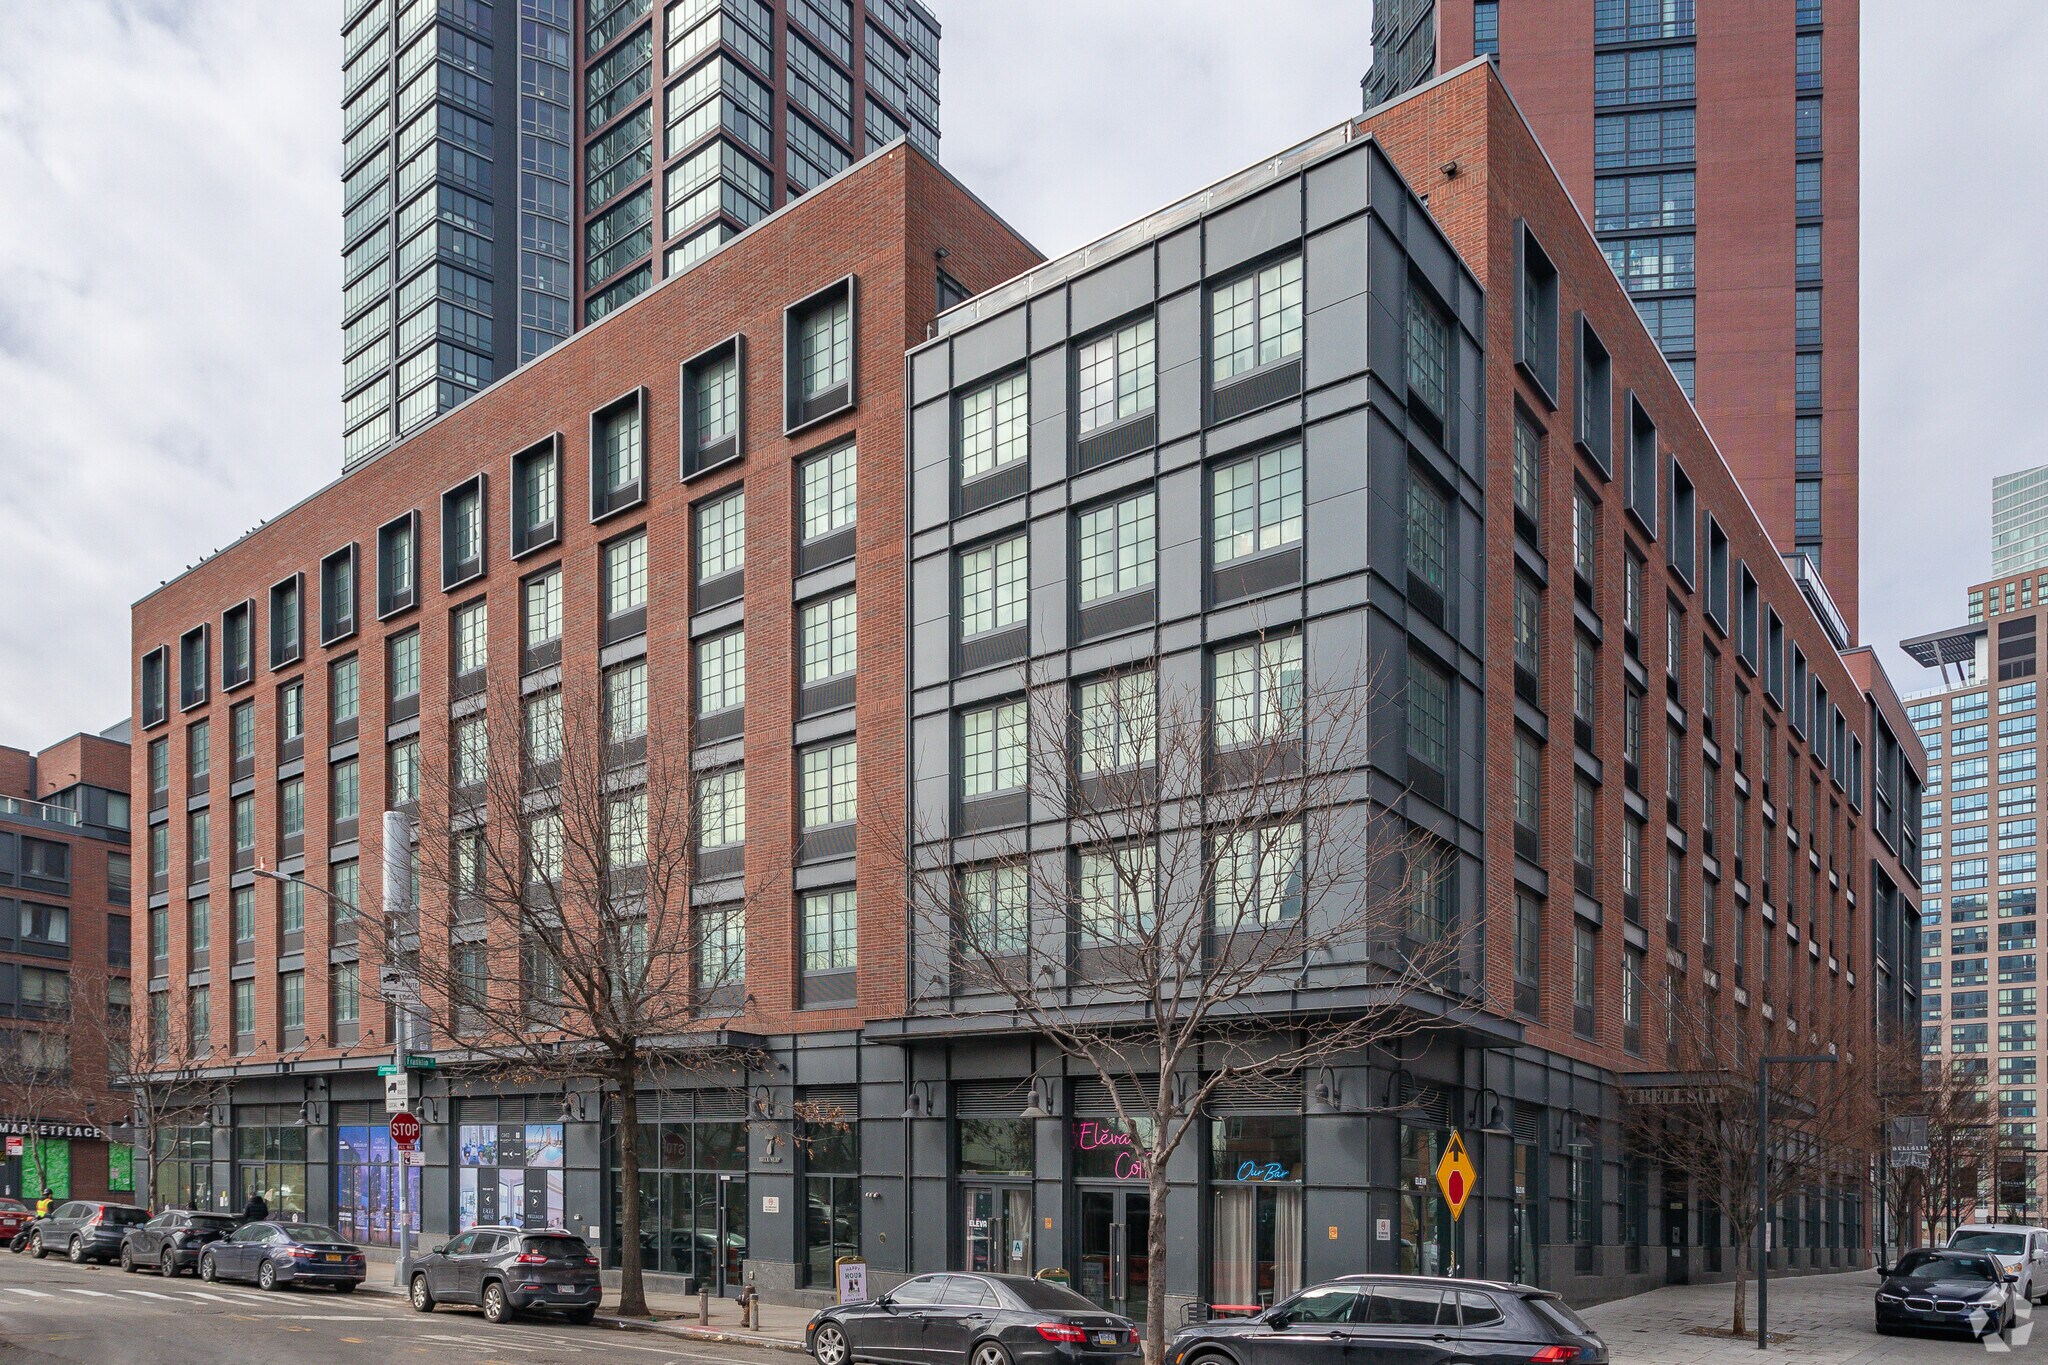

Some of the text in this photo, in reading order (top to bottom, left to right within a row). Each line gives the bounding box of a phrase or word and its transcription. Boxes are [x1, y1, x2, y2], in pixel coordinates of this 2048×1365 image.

[407, 1057, 428, 1066] Franklin
[392, 1123, 418, 1137] STOP
[1237, 1160, 1289, 1181] Our Bar
[1014, 1242, 1021, 1252] A
[844, 1272, 863, 1280] HOUR
